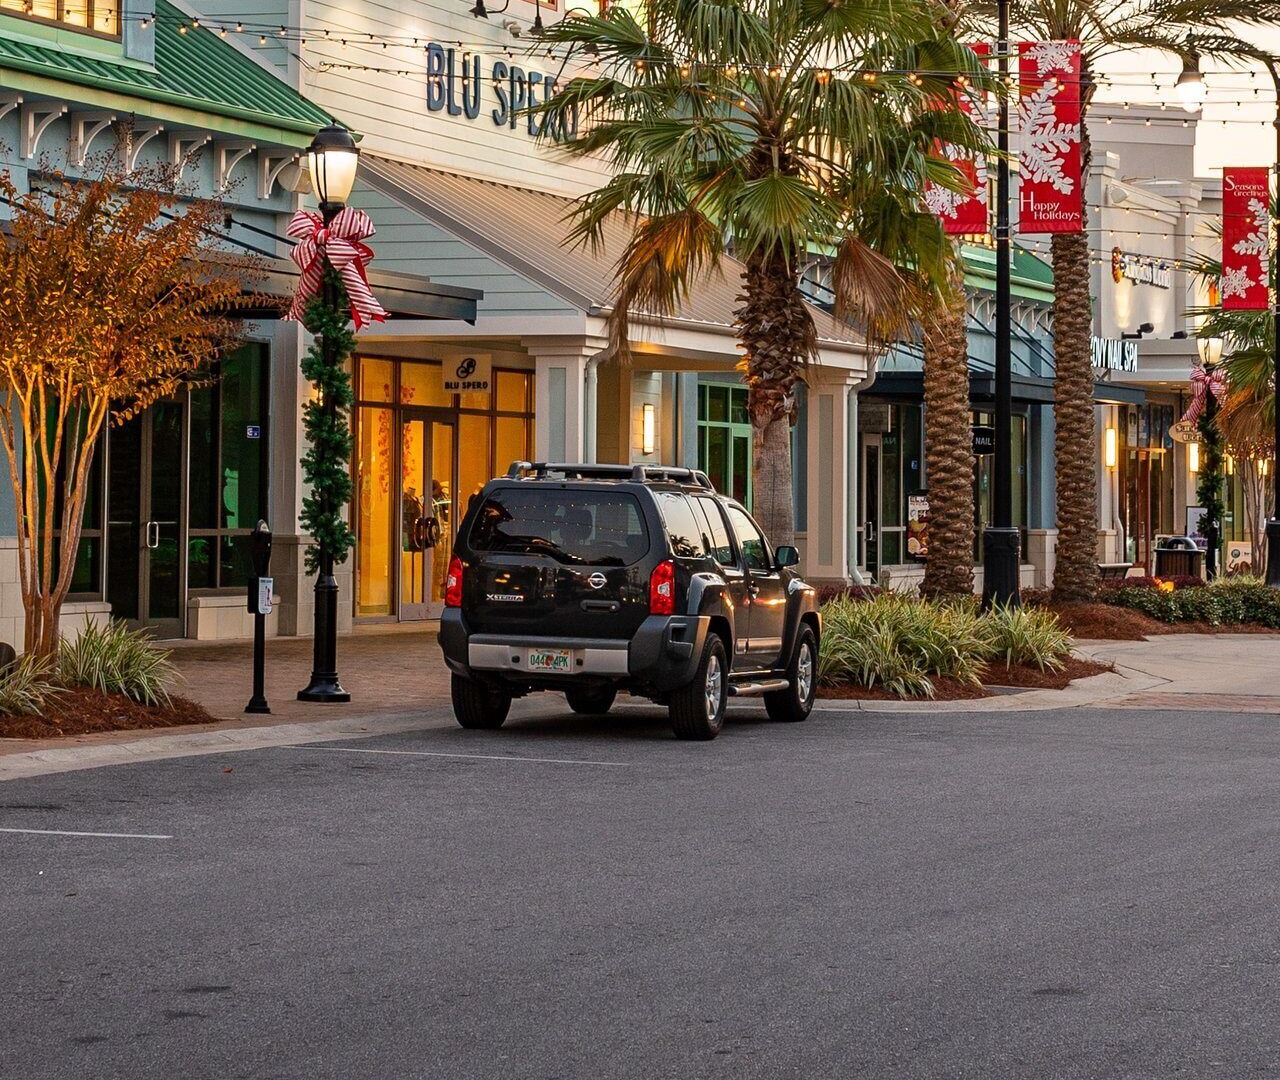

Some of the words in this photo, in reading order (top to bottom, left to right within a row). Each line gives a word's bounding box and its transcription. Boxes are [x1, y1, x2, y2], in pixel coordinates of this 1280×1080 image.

[427, 42, 480, 120] BLU
[1225, 175, 1264, 191] Seasons
[1021, 191, 1060, 213] Happy
[1034, 210, 1080, 221] Holidays
[1107, 338, 1123, 370] NAIL
[1124, 341, 1138, 372] SPA
[445, 381, 459, 390] BLU
[462, 381, 488, 390] SPERO
[975, 437, 991, 445] NAIL
